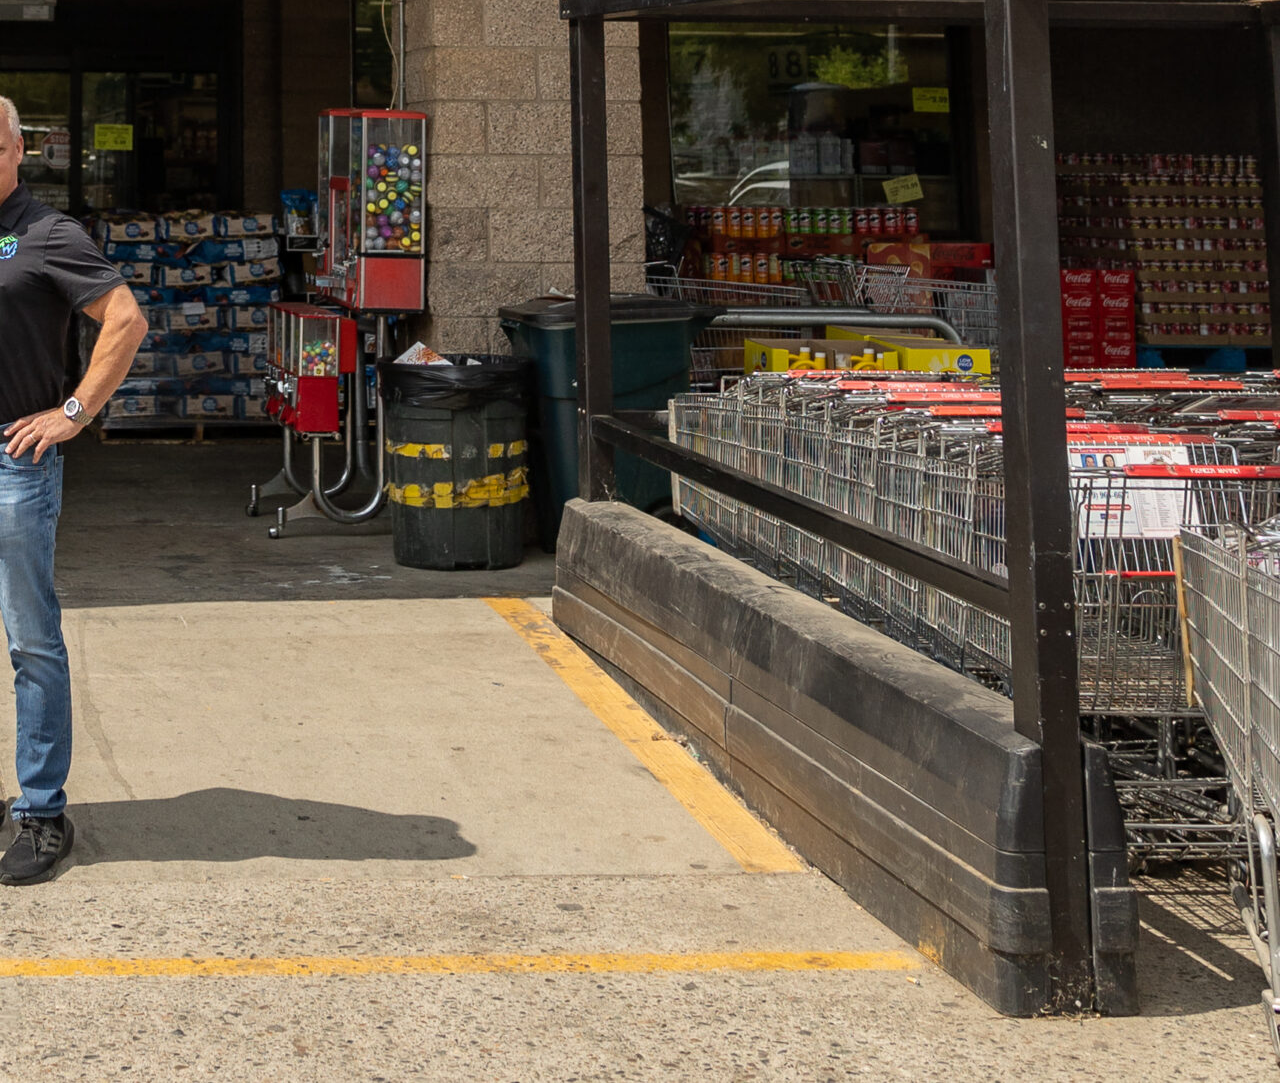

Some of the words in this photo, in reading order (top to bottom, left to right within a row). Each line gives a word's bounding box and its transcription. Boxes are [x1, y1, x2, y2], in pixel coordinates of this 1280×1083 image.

[1065, 273, 1091, 283] Coca-Cola
[1104, 273, 1130, 284] Coca-Cola
[1066, 297, 1091, 307] Coca-Cola
[1103, 297, 1129, 307] Coca-Cola
[1105, 345, 1131, 355] Coca-Cola
[1189, 467, 1216, 475] PIONEER
